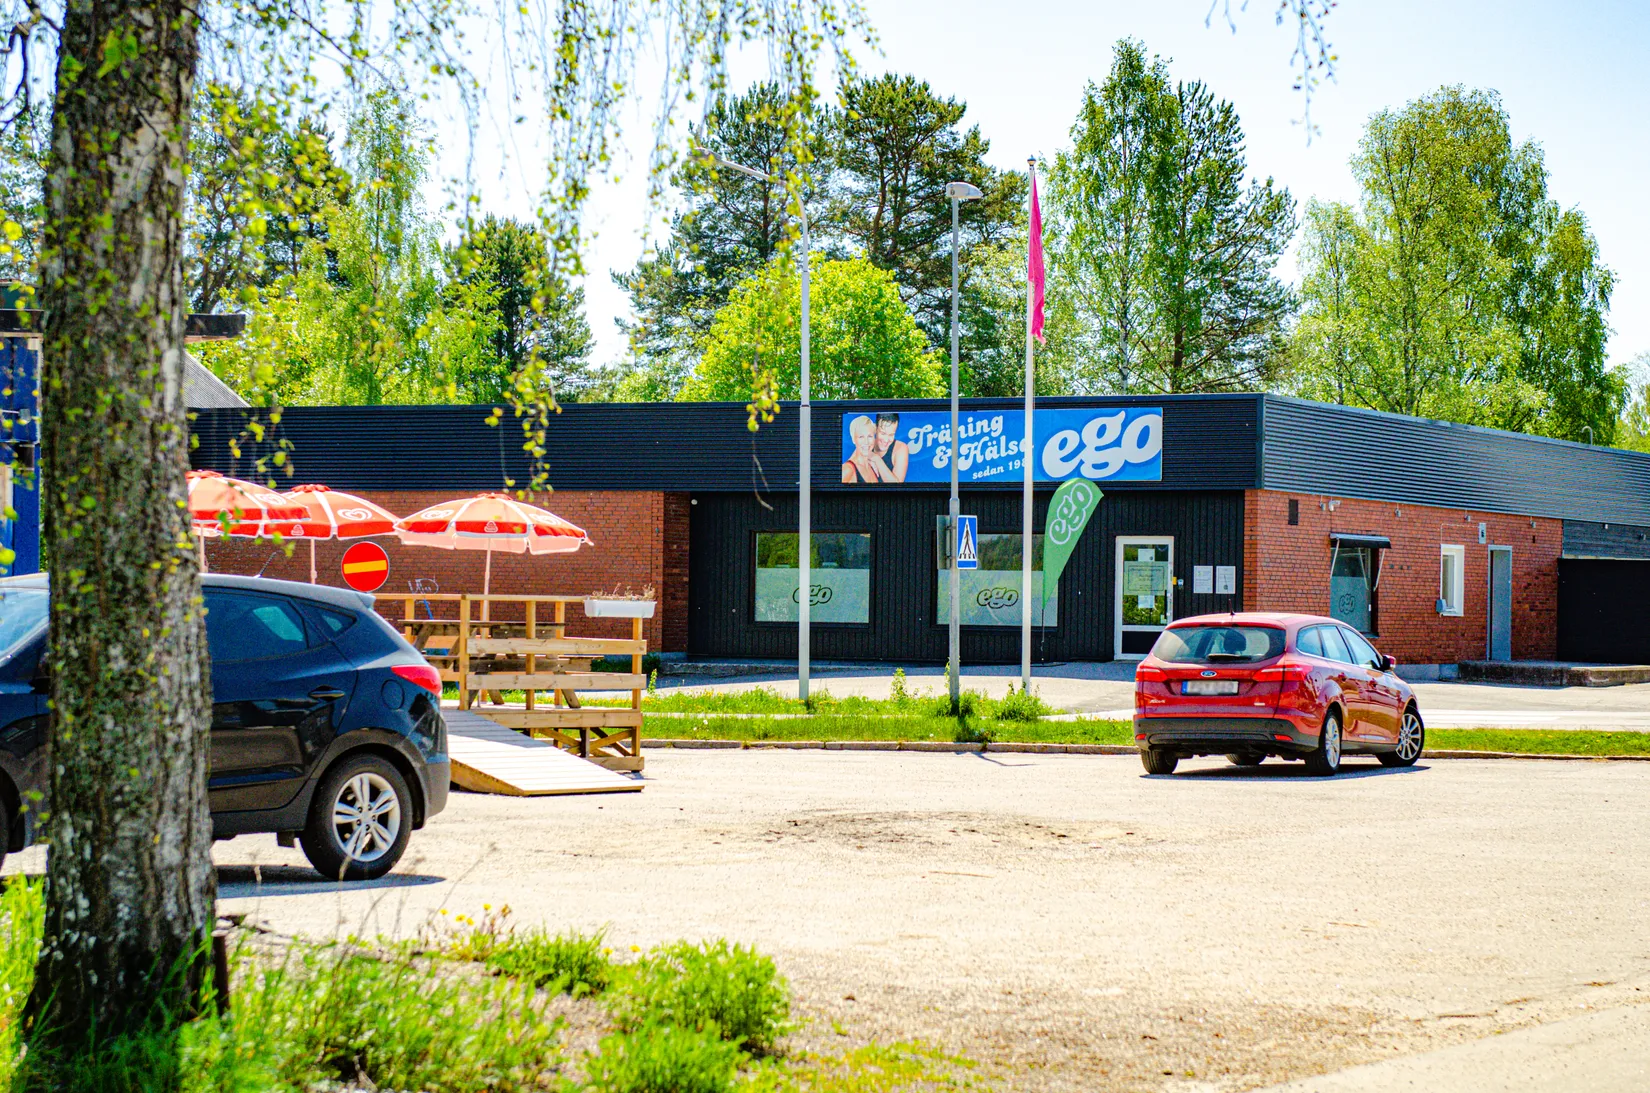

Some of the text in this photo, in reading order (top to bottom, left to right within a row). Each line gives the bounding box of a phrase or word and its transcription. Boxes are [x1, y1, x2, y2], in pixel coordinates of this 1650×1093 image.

[907, 415, 1004, 455] Träning
[1042, 410, 1162, 479] ego
[932, 445, 952, 469] &
[972, 465, 1005, 480] sedan
[1049, 482, 1093, 545] ego
[976, 586, 1019, 609] ego
